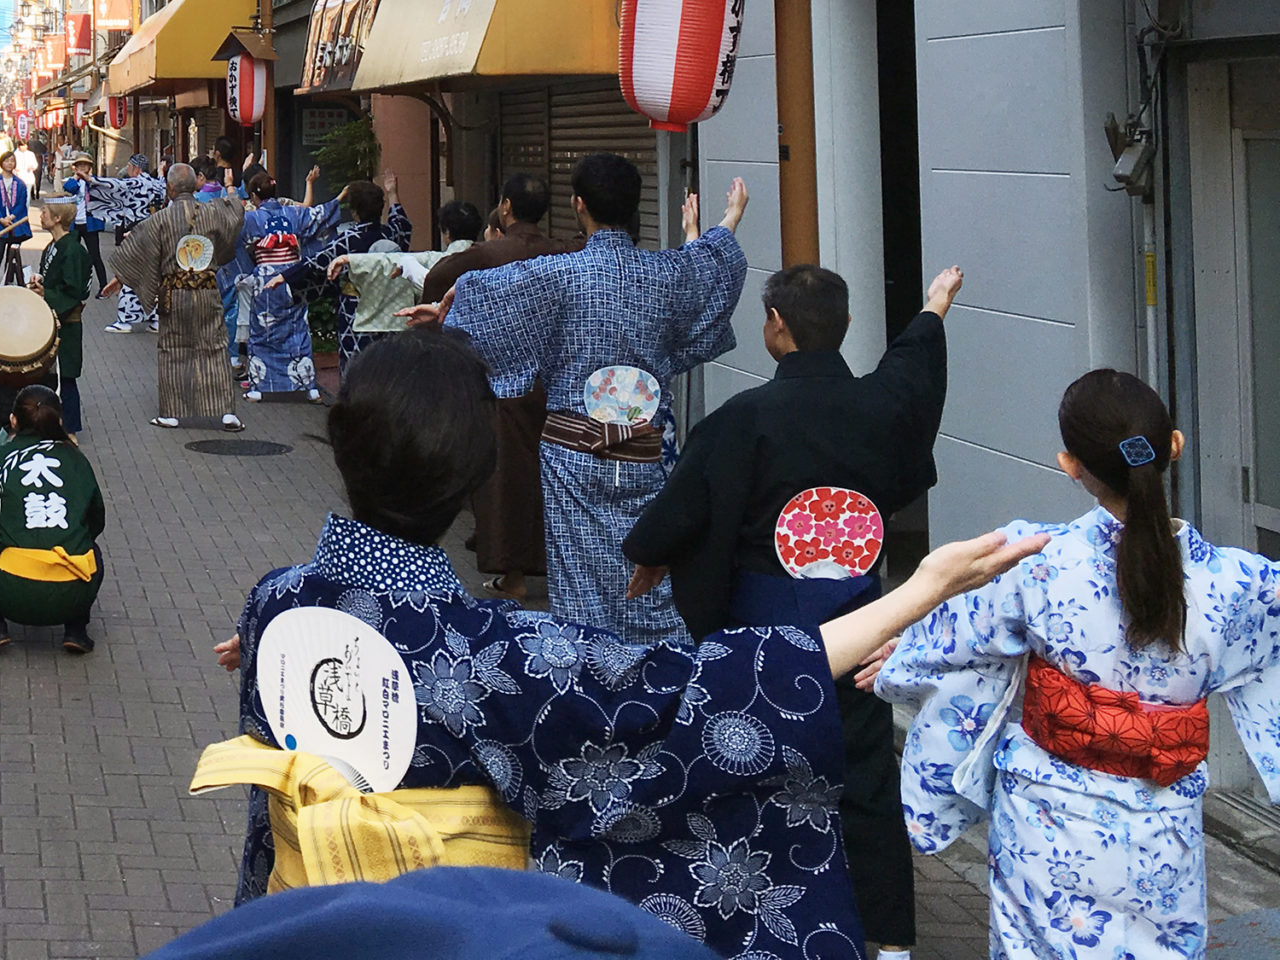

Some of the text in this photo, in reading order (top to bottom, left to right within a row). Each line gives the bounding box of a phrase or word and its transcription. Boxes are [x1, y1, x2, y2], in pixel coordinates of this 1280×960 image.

[19, 453, 69, 530] 太鼓
[317, 660, 353, 732] 浅草橋
